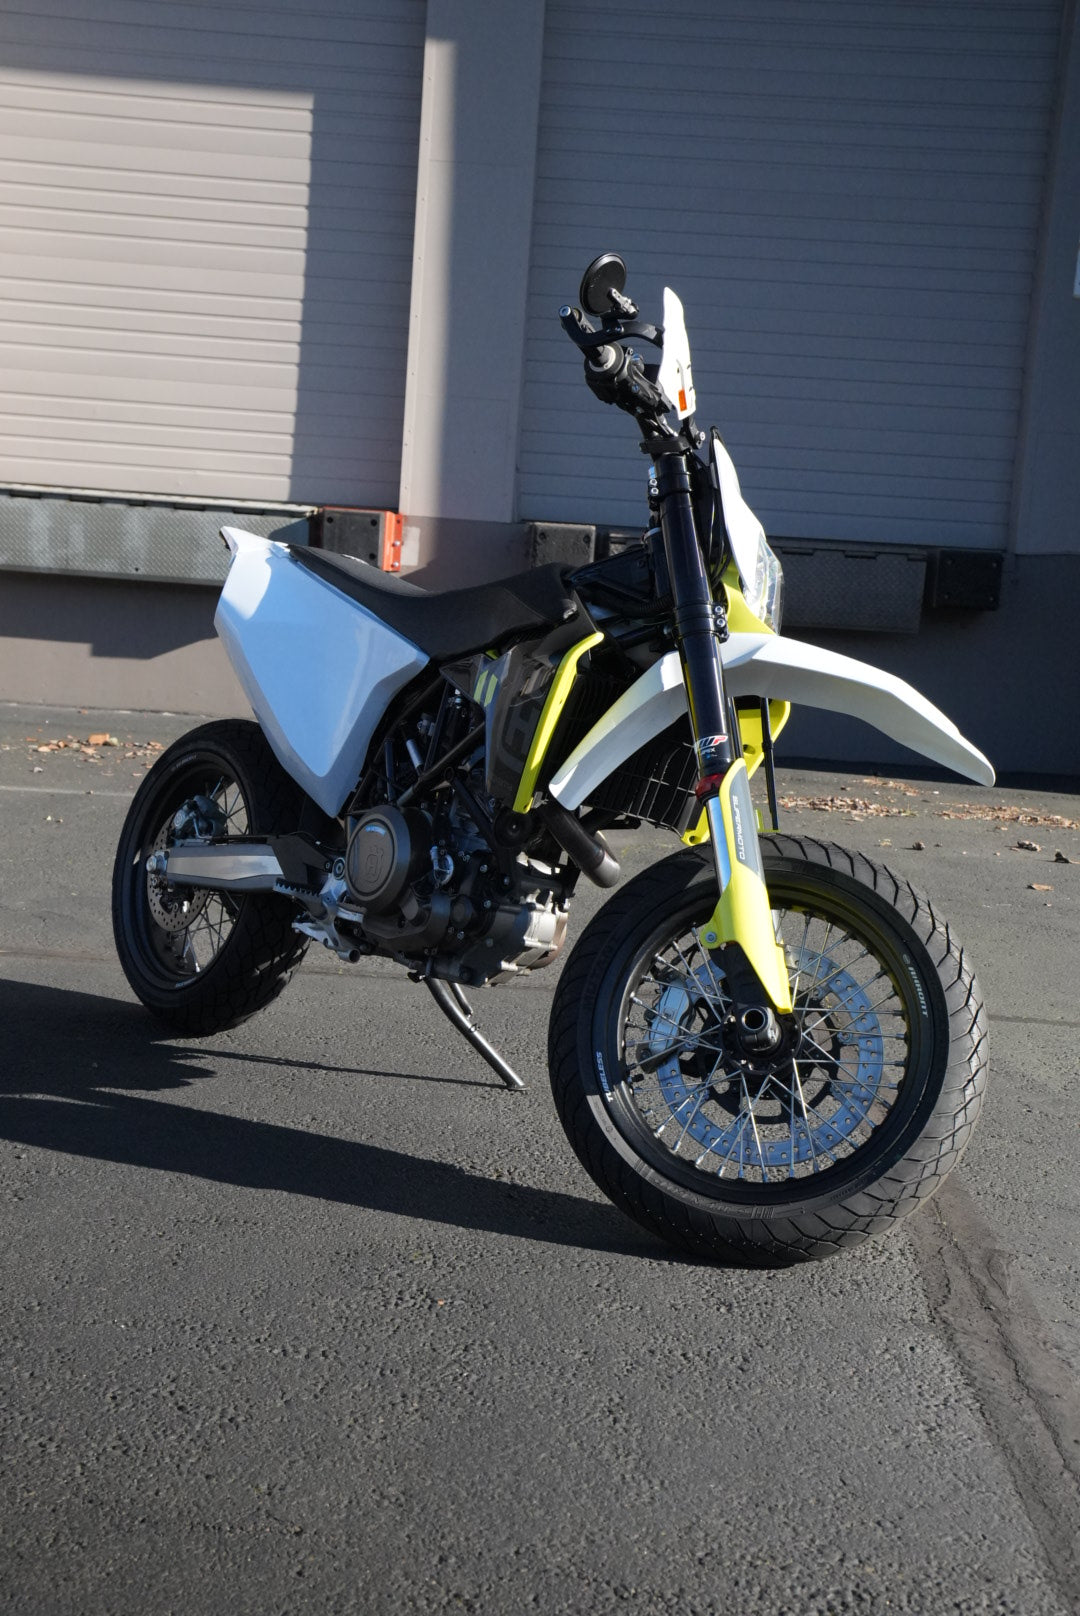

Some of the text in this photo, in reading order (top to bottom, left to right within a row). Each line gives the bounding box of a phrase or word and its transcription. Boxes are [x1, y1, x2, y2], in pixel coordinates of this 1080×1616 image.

[697, 735, 728, 750] WP
[732, 795, 746, 860] SUPERMOTO
[596, 1051, 614, 1103] TUBELESS
